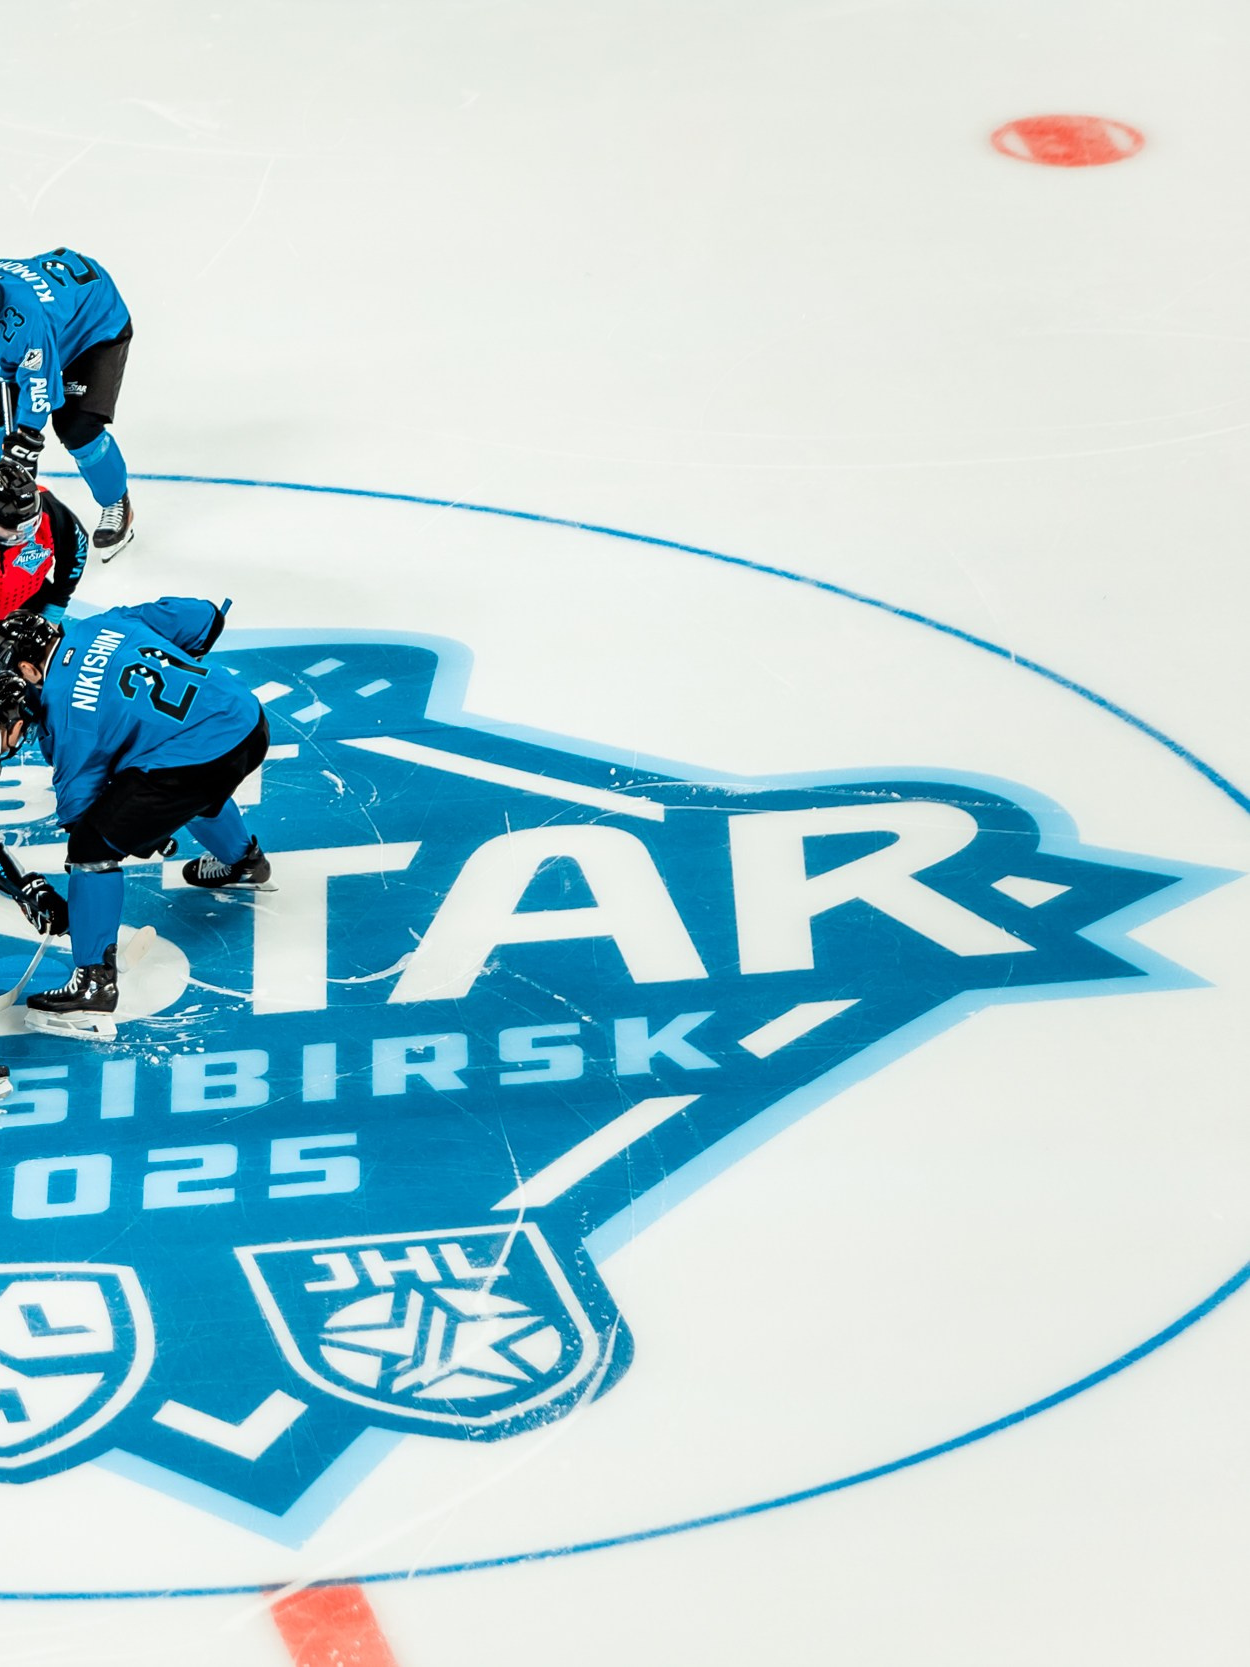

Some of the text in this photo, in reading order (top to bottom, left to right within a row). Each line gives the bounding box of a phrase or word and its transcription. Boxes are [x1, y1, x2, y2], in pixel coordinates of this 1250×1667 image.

[0, 306, 26, 343] 23
[71, 628, 126, 712] NIKISHIN
[117, 646, 212, 725] 21
[304, 1243, 509, 1293] JHL
